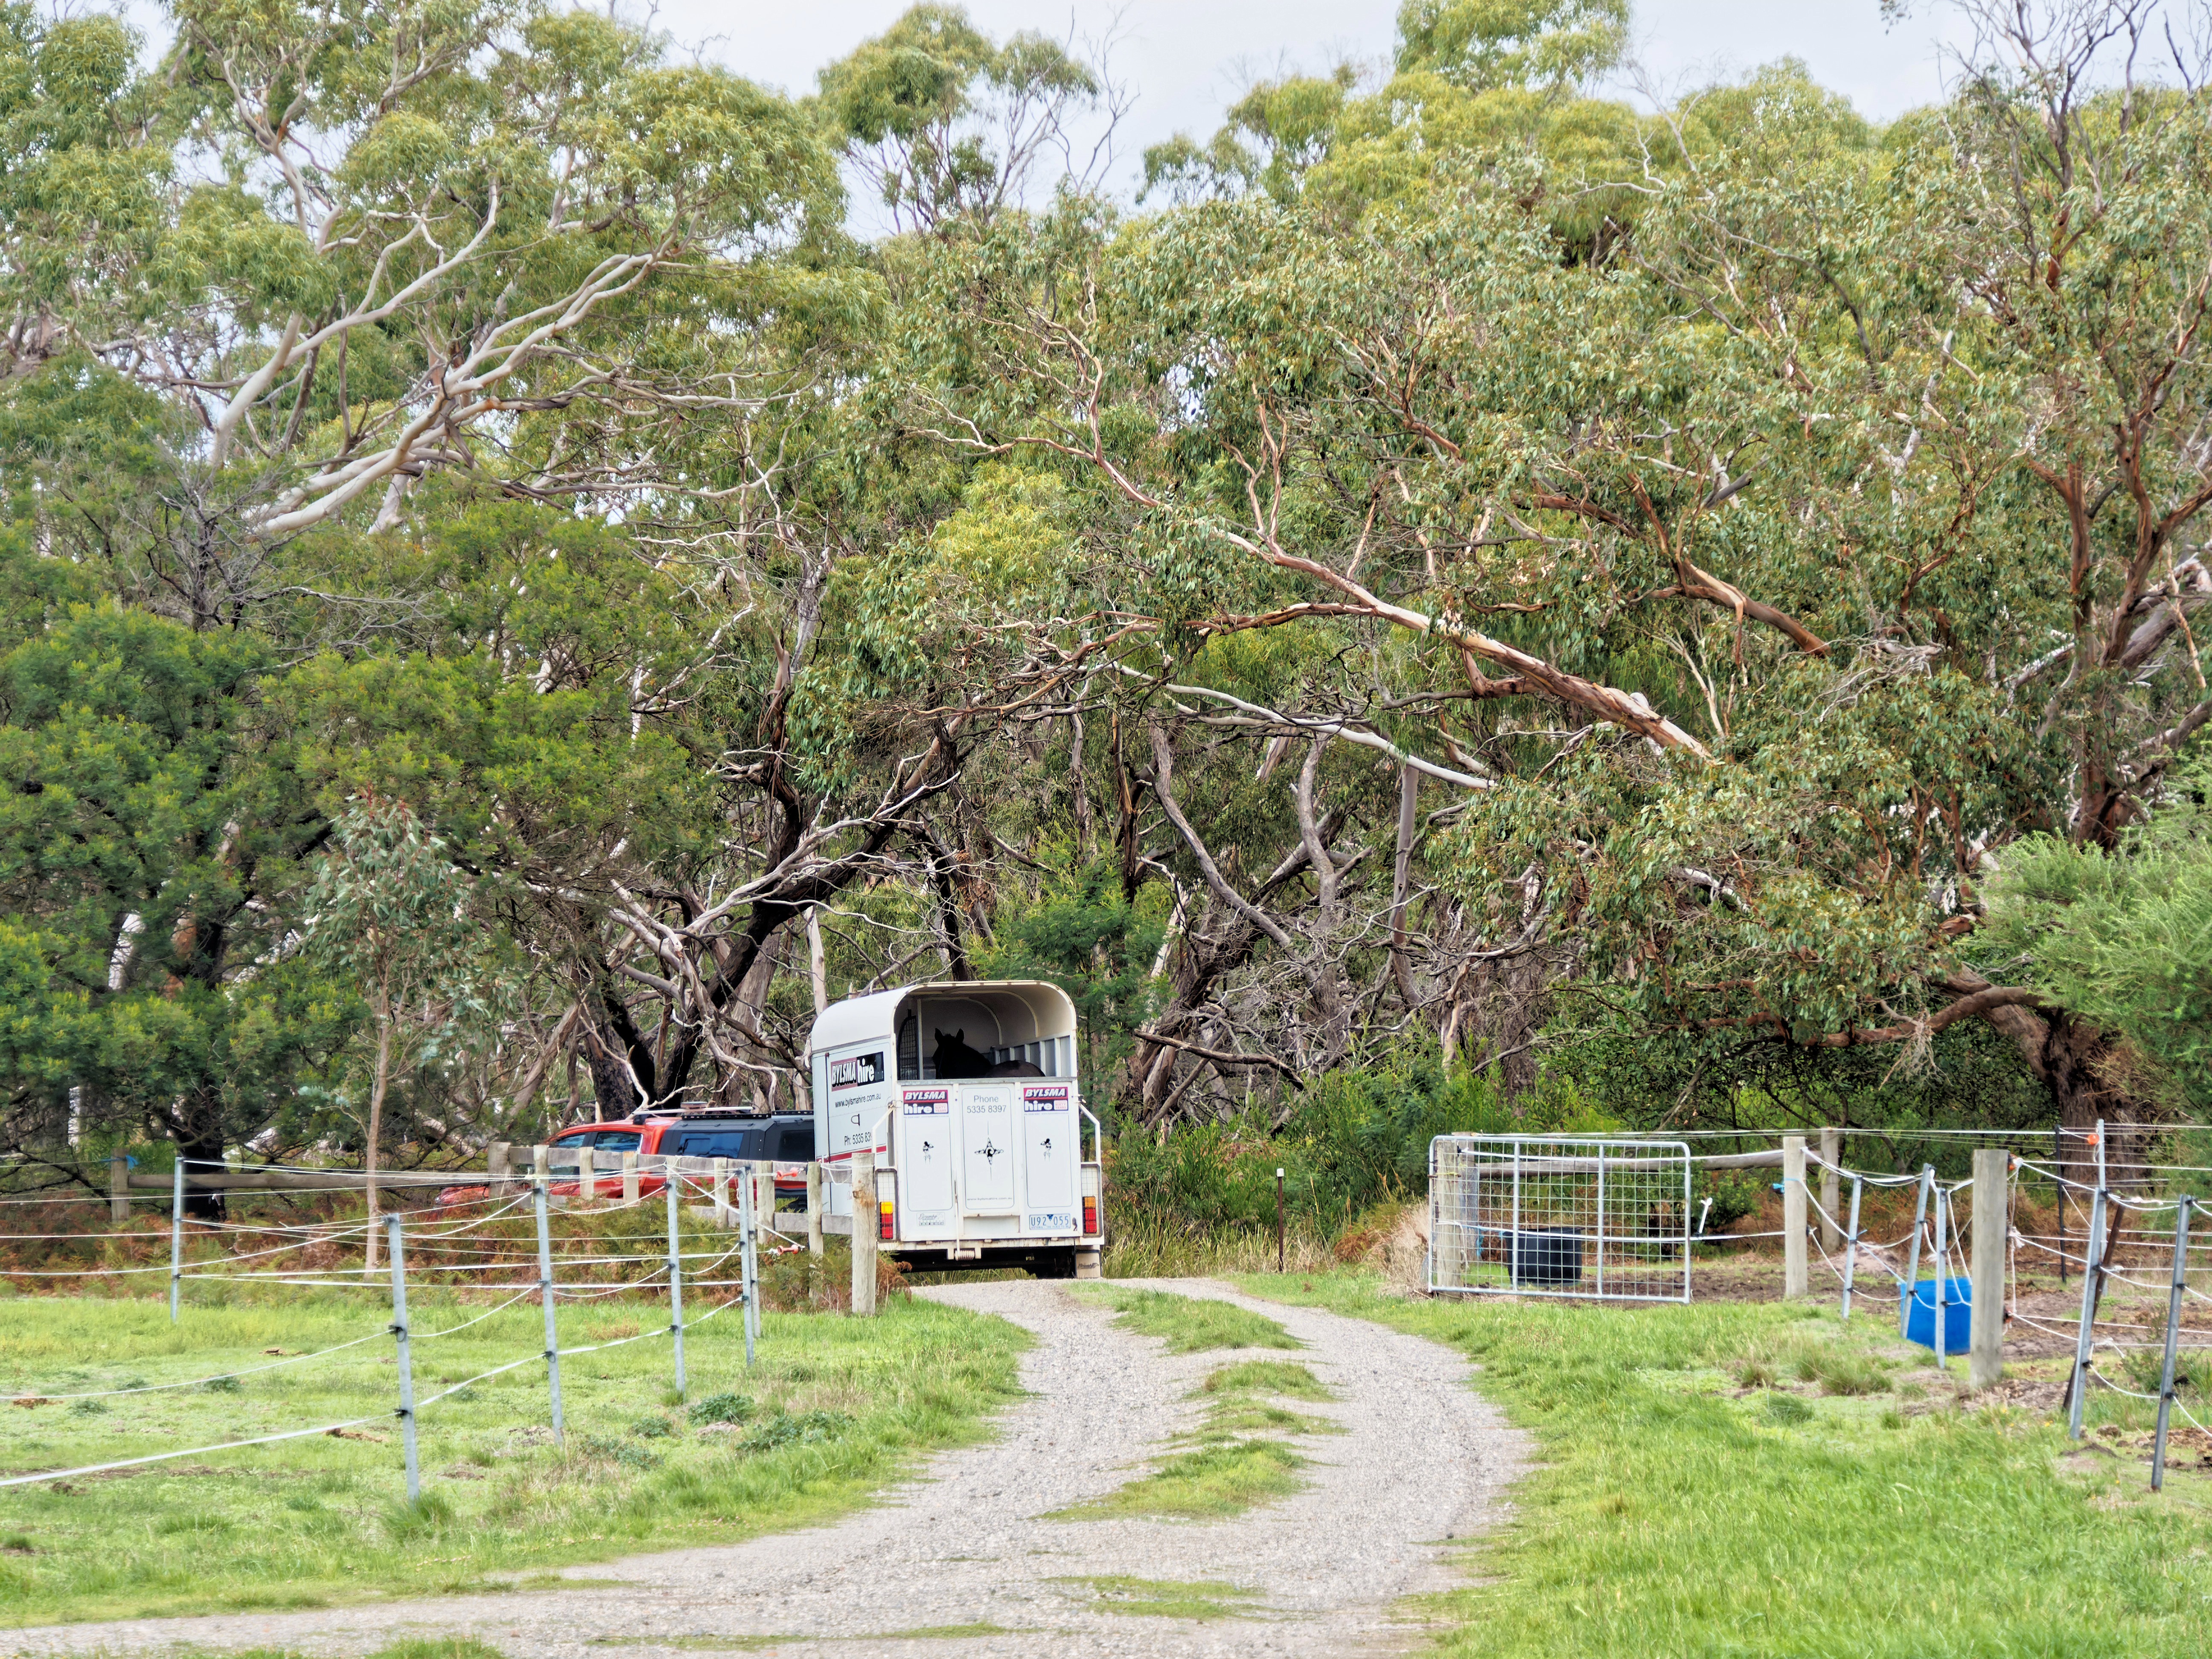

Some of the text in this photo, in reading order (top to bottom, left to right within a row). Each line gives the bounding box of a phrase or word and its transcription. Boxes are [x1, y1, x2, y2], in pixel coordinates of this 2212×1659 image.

[832, 1058, 875, 1085] BYLSMA hire
[905, 1091, 946, 1100] BYLSMA
[1025, 1088, 1066, 1097] BYLSMA
[835, 1092, 881, 1108] www.bylsmahire.com.au
[1025, 1100, 1053, 1111] hire
[904, 1103, 932, 1114] hire
[967, 1105, 1007, 1113] 5335 8397
[853, 1133, 864, 1144] 5335
[1031, 1216, 1069, 1226] U92 055
